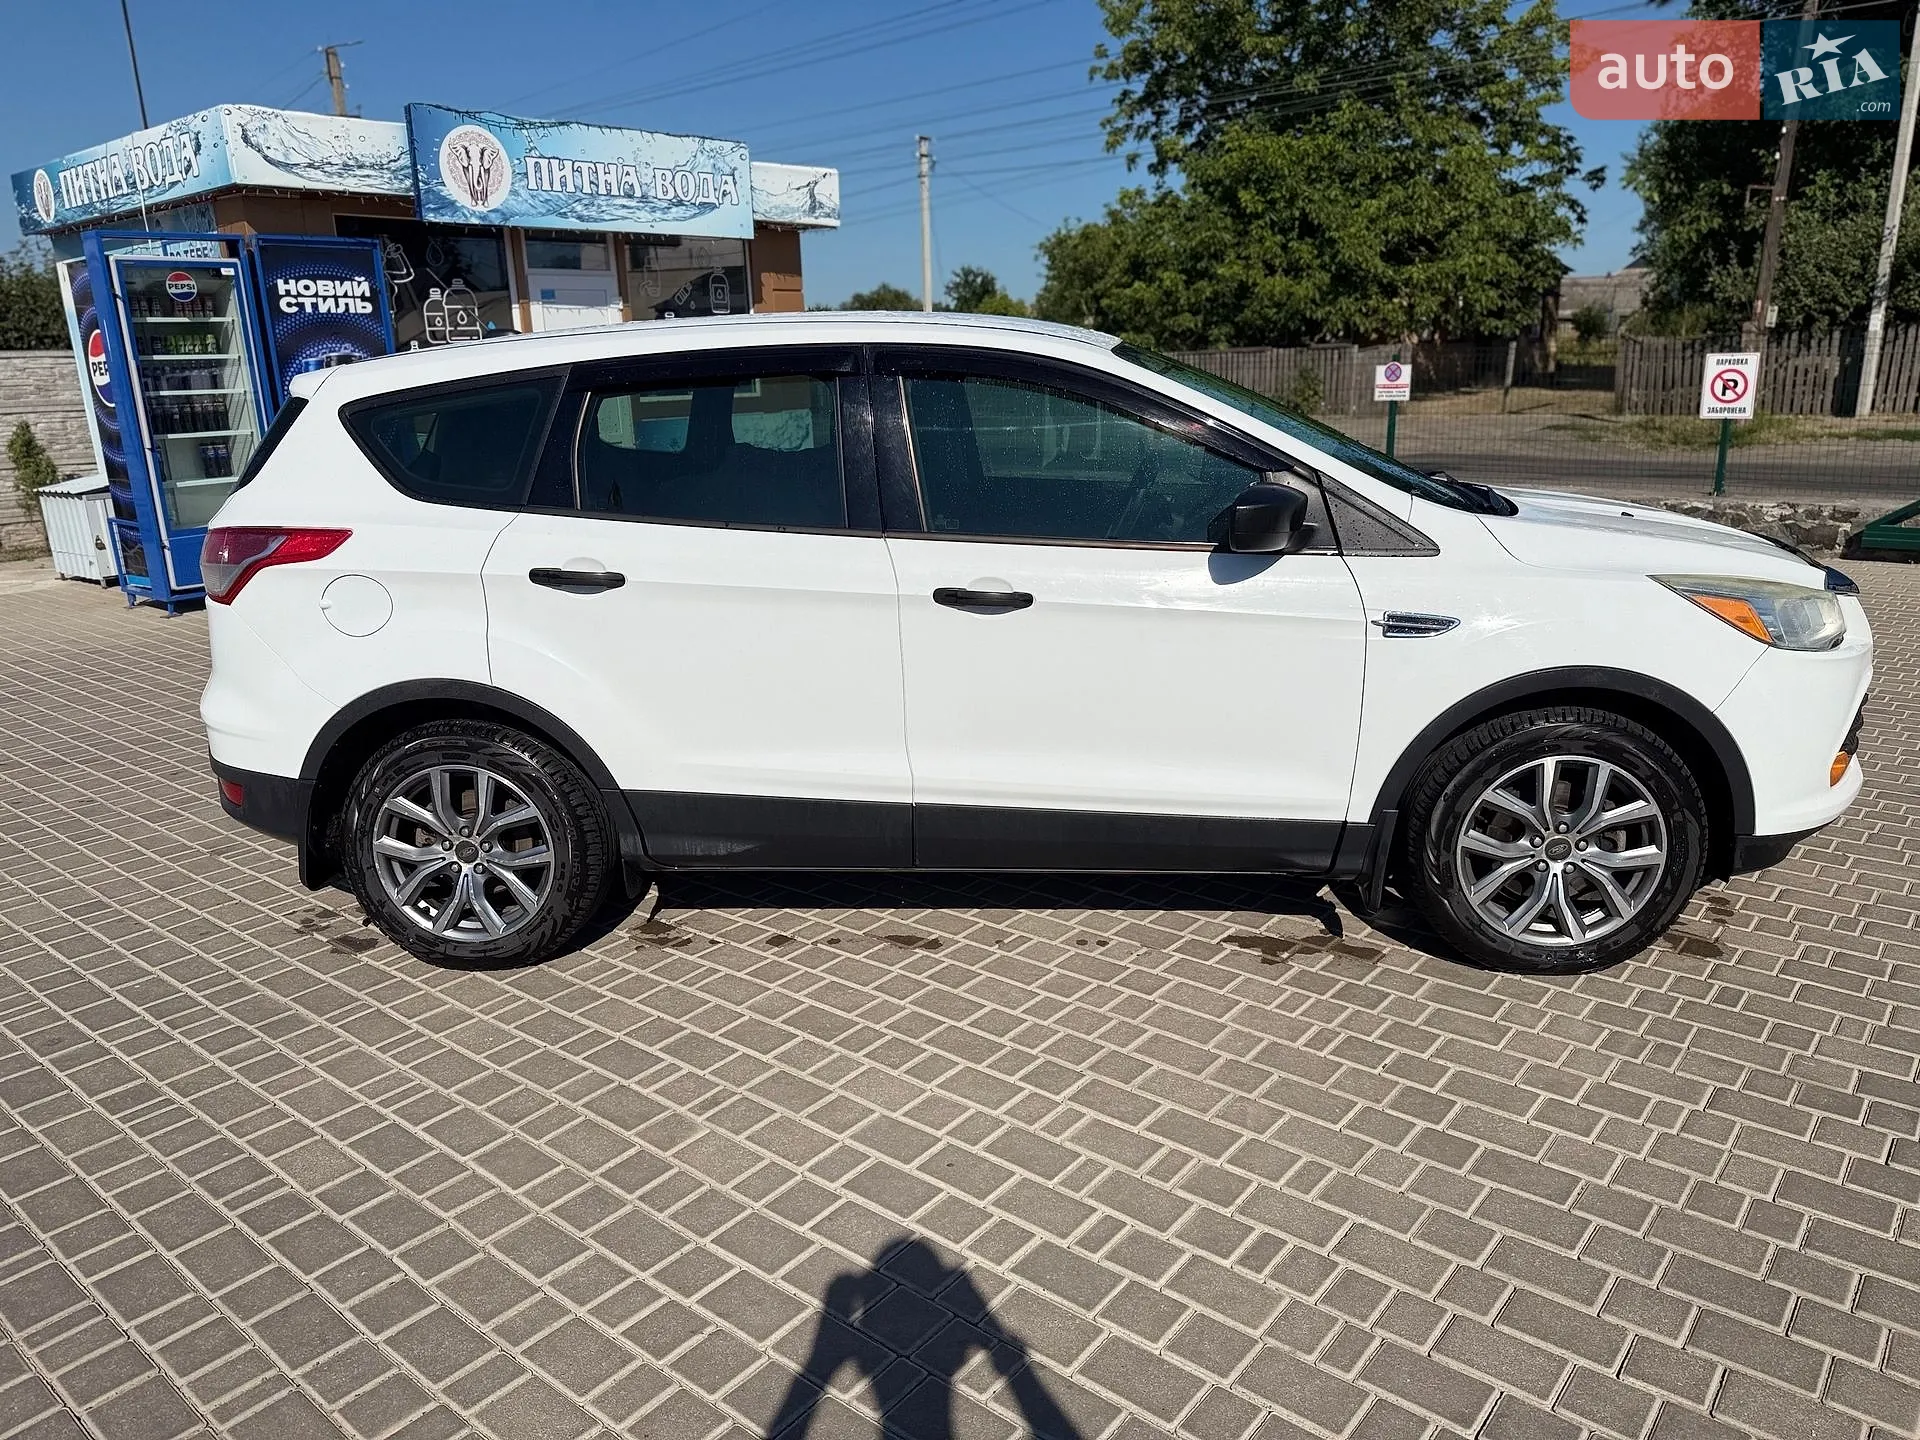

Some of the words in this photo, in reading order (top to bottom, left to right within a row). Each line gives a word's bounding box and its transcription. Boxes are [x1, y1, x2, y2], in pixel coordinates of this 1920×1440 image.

[58, 152, 128, 209] ПИТНА
[129, 131, 200, 190] ВОДА
[524, 156, 642, 197] ПИТНА
[653, 167, 739, 207] ВОДА
[168, 283, 195, 291] PEPSI
[277, 276, 371, 297] НОВИЙ
[279, 296, 373, 314] СТИЛЬ
[91, 361, 109, 377] PEP
[1716, 358, 1748, 366] ПАРКОВКА
[1706, 406, 1747, 414] ЗАБОРОНЕНА
